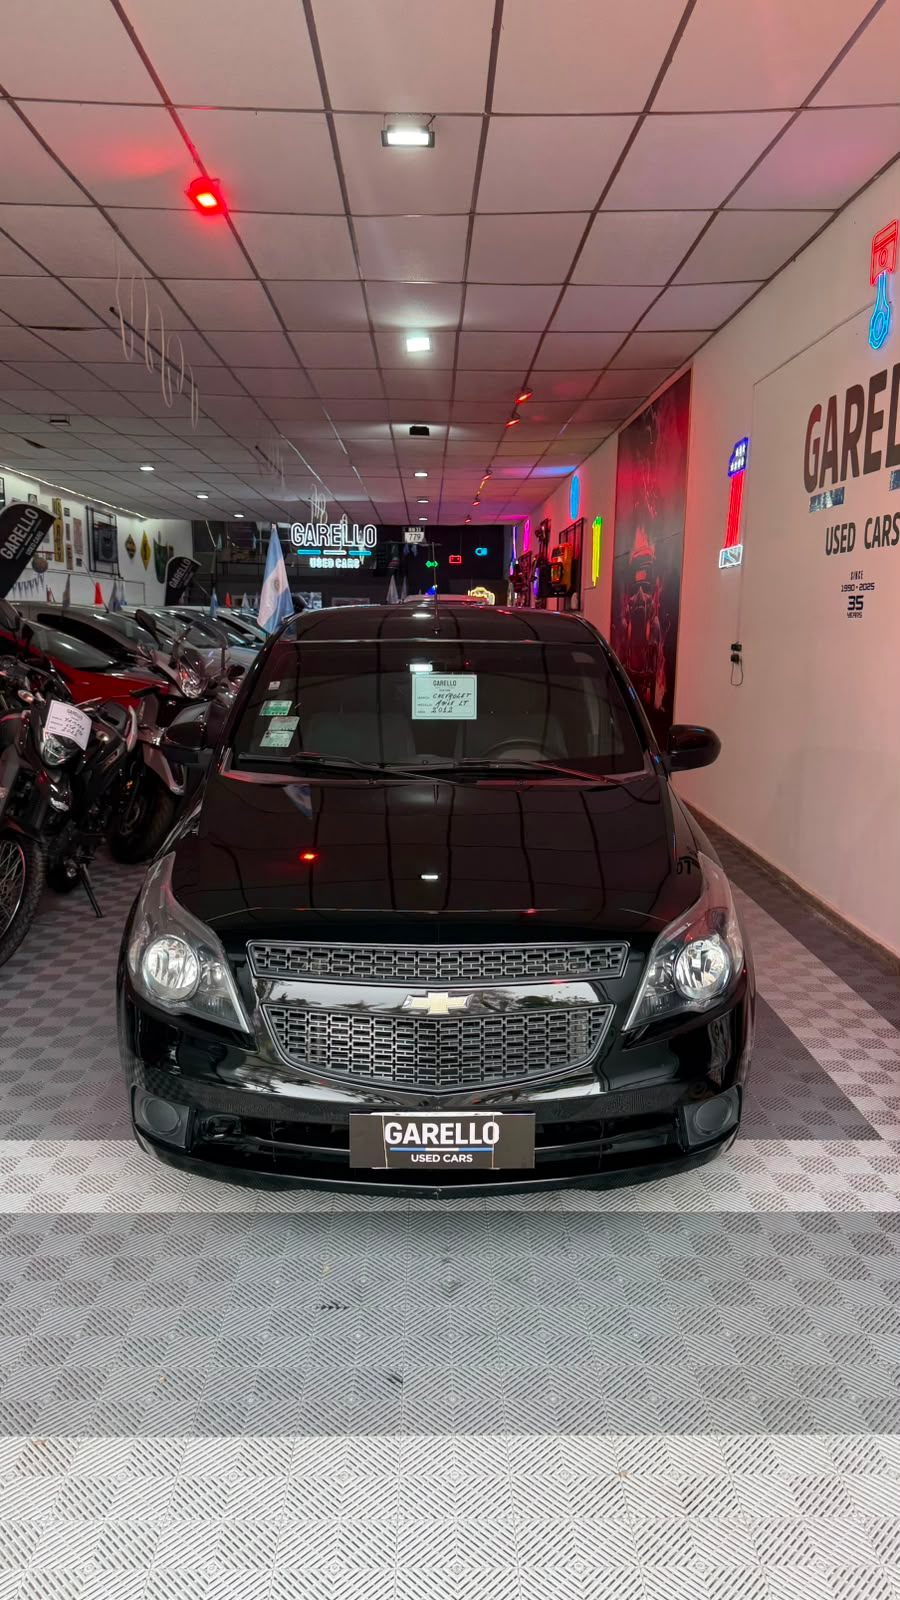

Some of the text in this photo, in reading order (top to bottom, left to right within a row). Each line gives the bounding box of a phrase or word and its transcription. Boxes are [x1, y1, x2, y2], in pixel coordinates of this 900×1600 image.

[0, 508, 39, 559] GARELLO
[291, 522, 377, 548] GARELLO
[825, 512, 900, 556] USED CARS
[309, 557, 360, 569] USED CARS
[847, 595, 864, 611] 35
[384, 1121, 500, 1145] GARELLO
[410, 1154, 473, 1163] USED CARS
